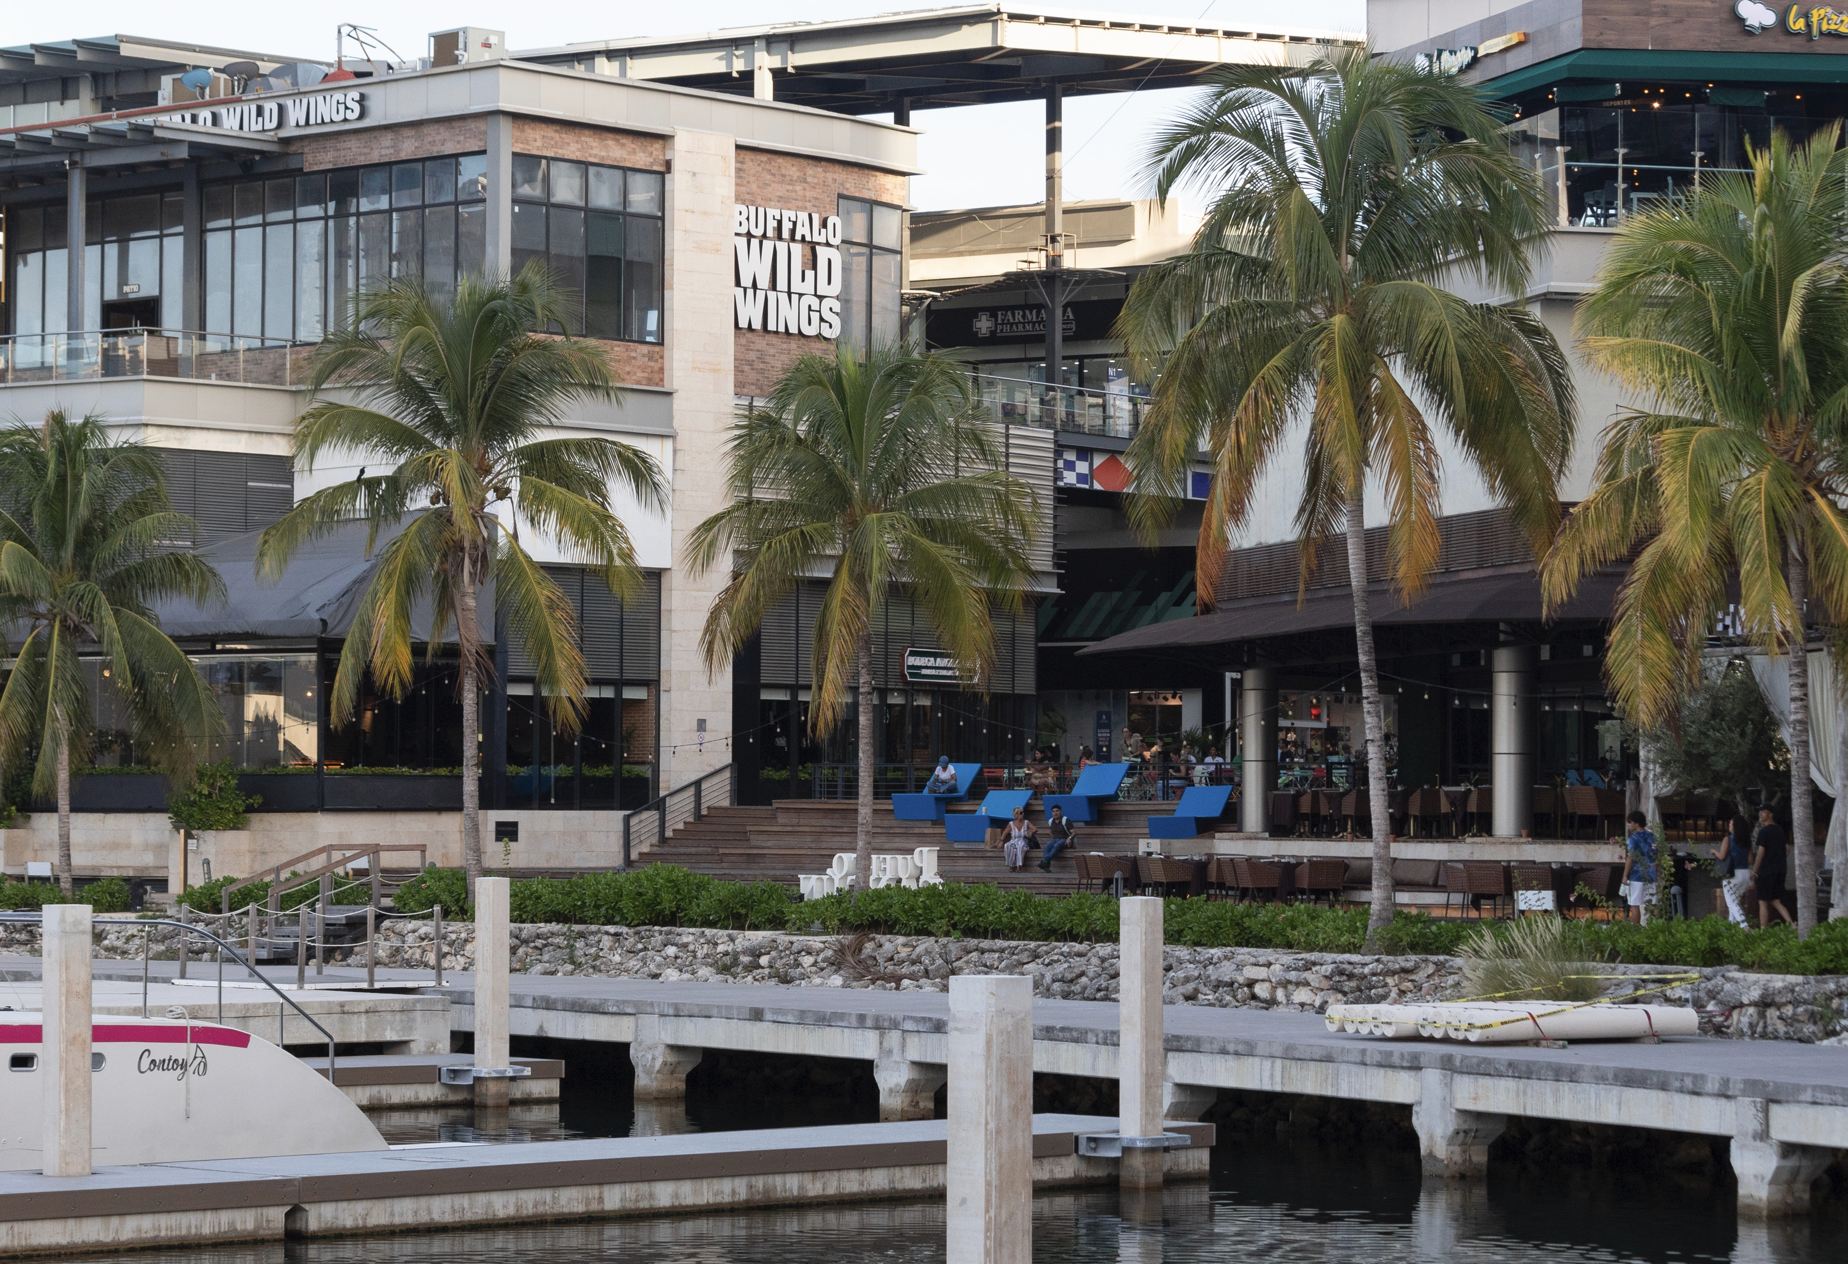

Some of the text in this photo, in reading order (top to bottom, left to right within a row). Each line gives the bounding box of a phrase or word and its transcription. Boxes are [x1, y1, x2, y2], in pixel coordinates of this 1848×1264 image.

[220, 101, 279, 132] WILD
[286, 91, 361, 127] WINGS
[735, 204, 842, 246] BUFFALO
[735, 238, 842, 297] WILD
[735, 287, 841, 339] WINGS
[996, 307, 1075, 324] FARMAA
[996, 321, 1048, 333] PHARMAC
[137, 1048, 188, 1082] Contoy
